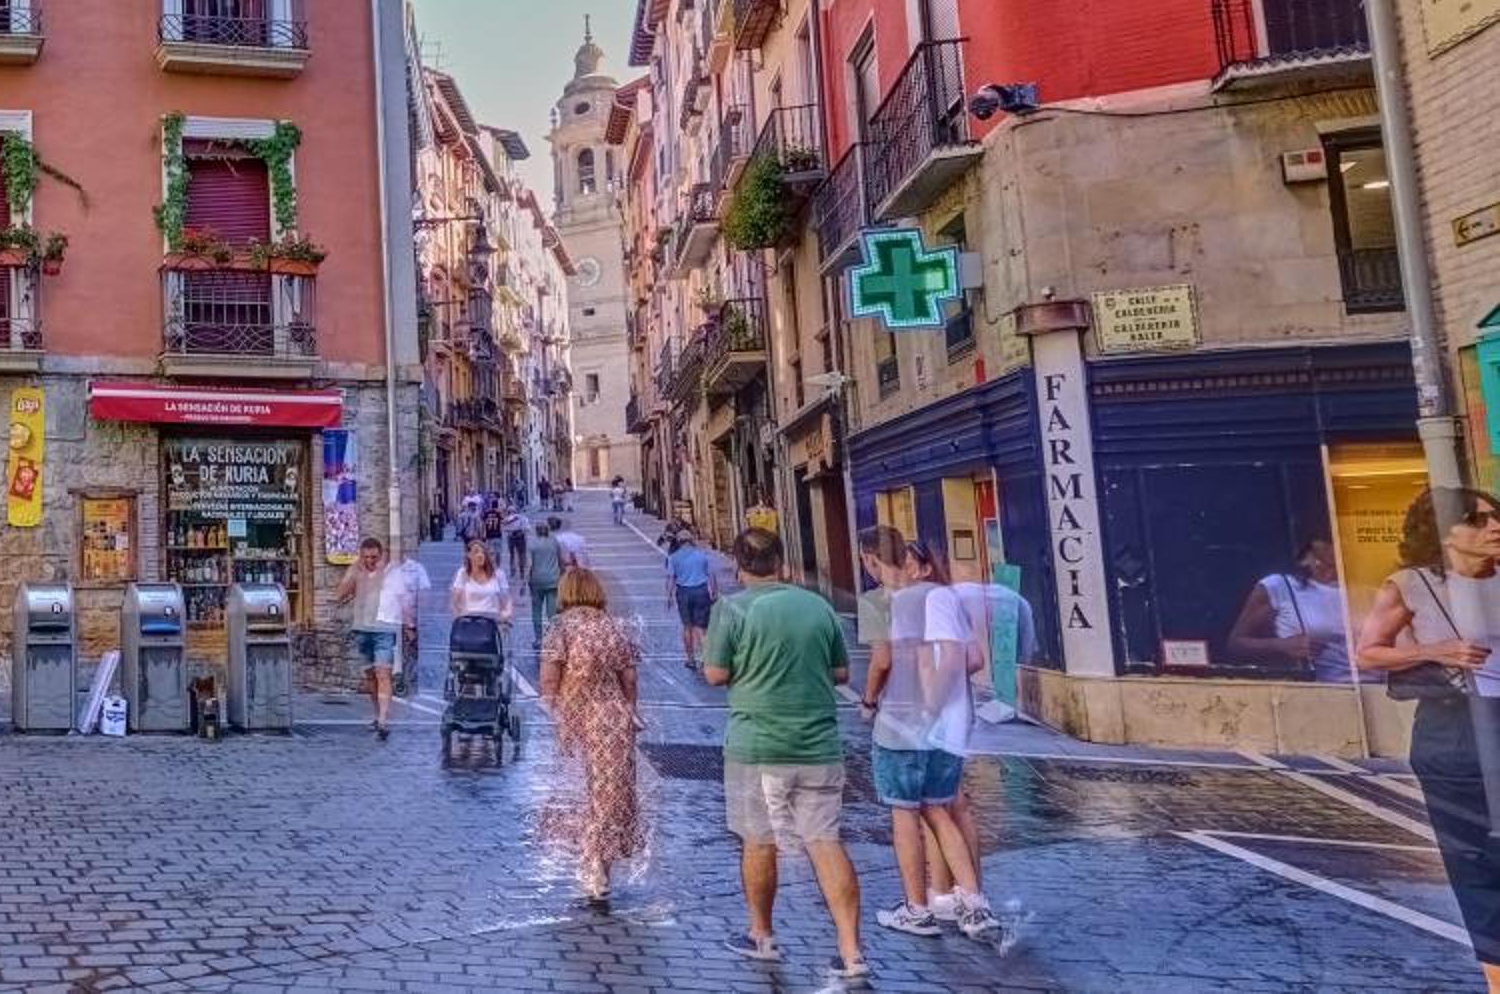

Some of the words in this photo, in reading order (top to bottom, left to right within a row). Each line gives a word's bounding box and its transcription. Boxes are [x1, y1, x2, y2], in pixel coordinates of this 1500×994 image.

[164, 401, 177, 411] LA
[230, 404, 242, 413] DE
[183, 445, 201, 463] LA
[199, 465, 219, 481] DE
[1044, 373, 1093, 629] FARMACIA
